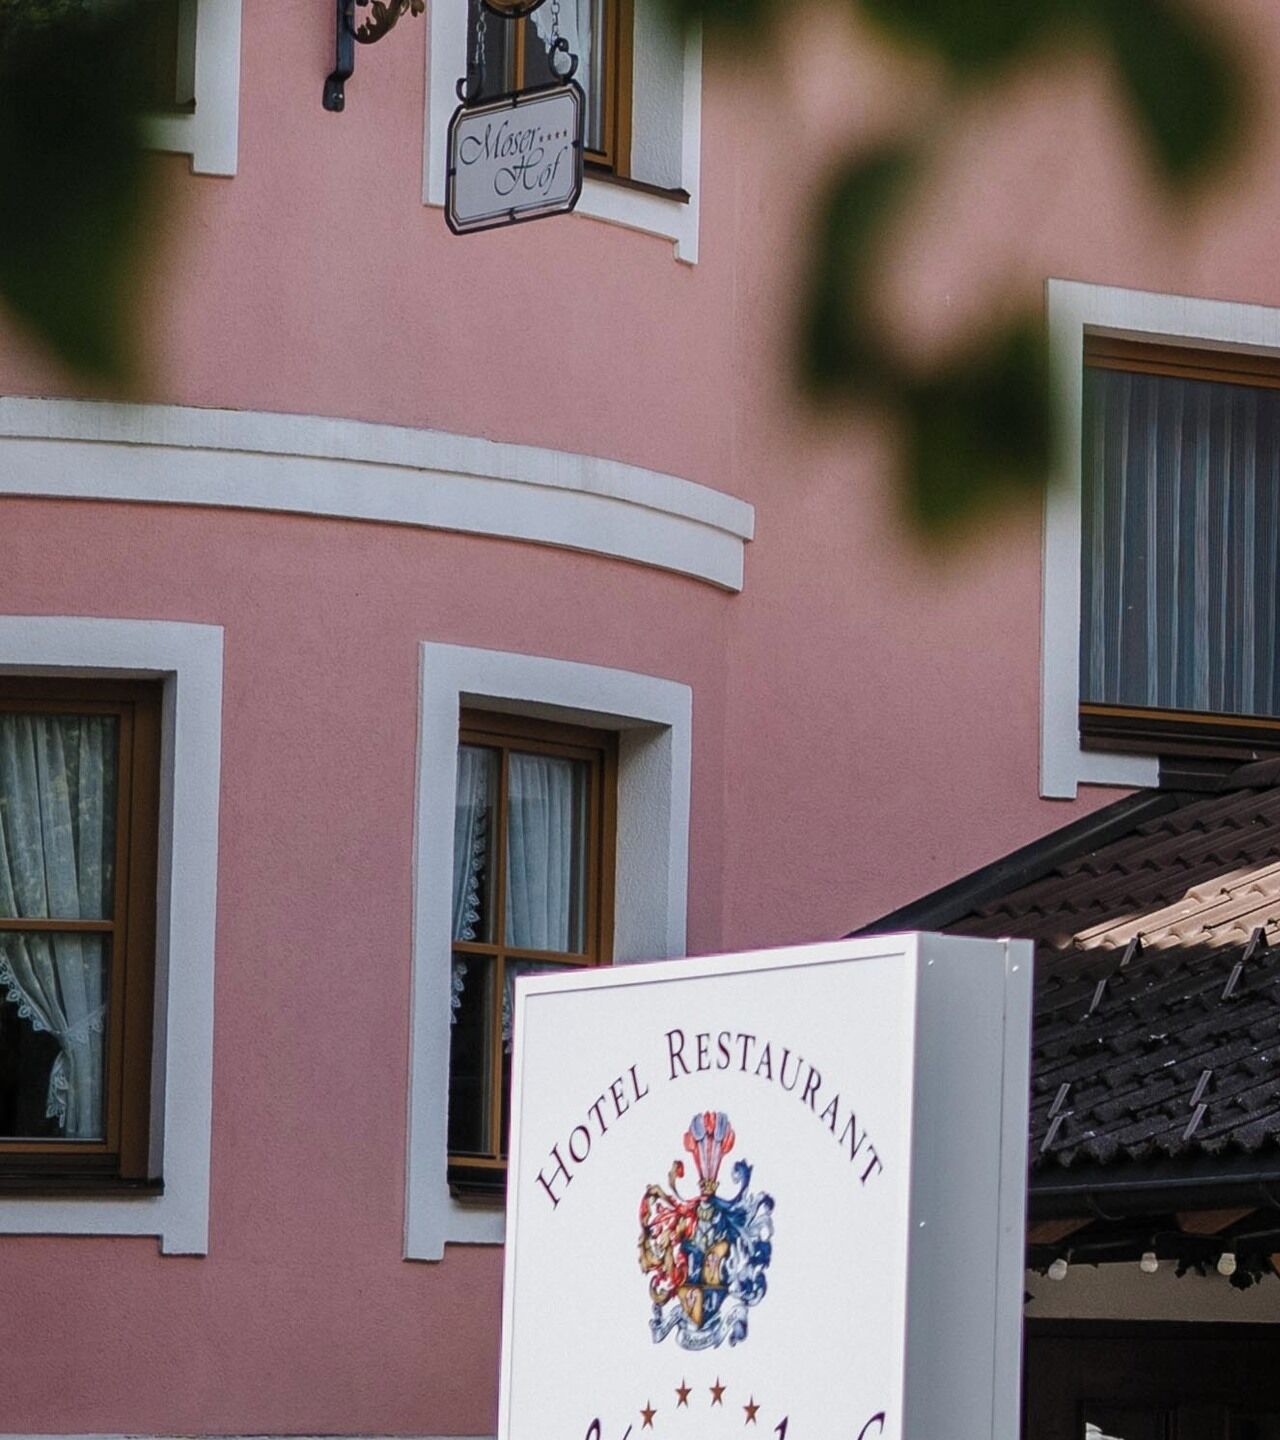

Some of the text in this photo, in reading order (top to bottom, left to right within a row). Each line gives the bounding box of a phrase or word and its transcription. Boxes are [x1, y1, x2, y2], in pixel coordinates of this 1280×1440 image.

[459, 119, 541, 165] Moser
[494, 145, 568, 196] Hof
[535, 1028, 884, 1211] HOTEL RESTAURANT
